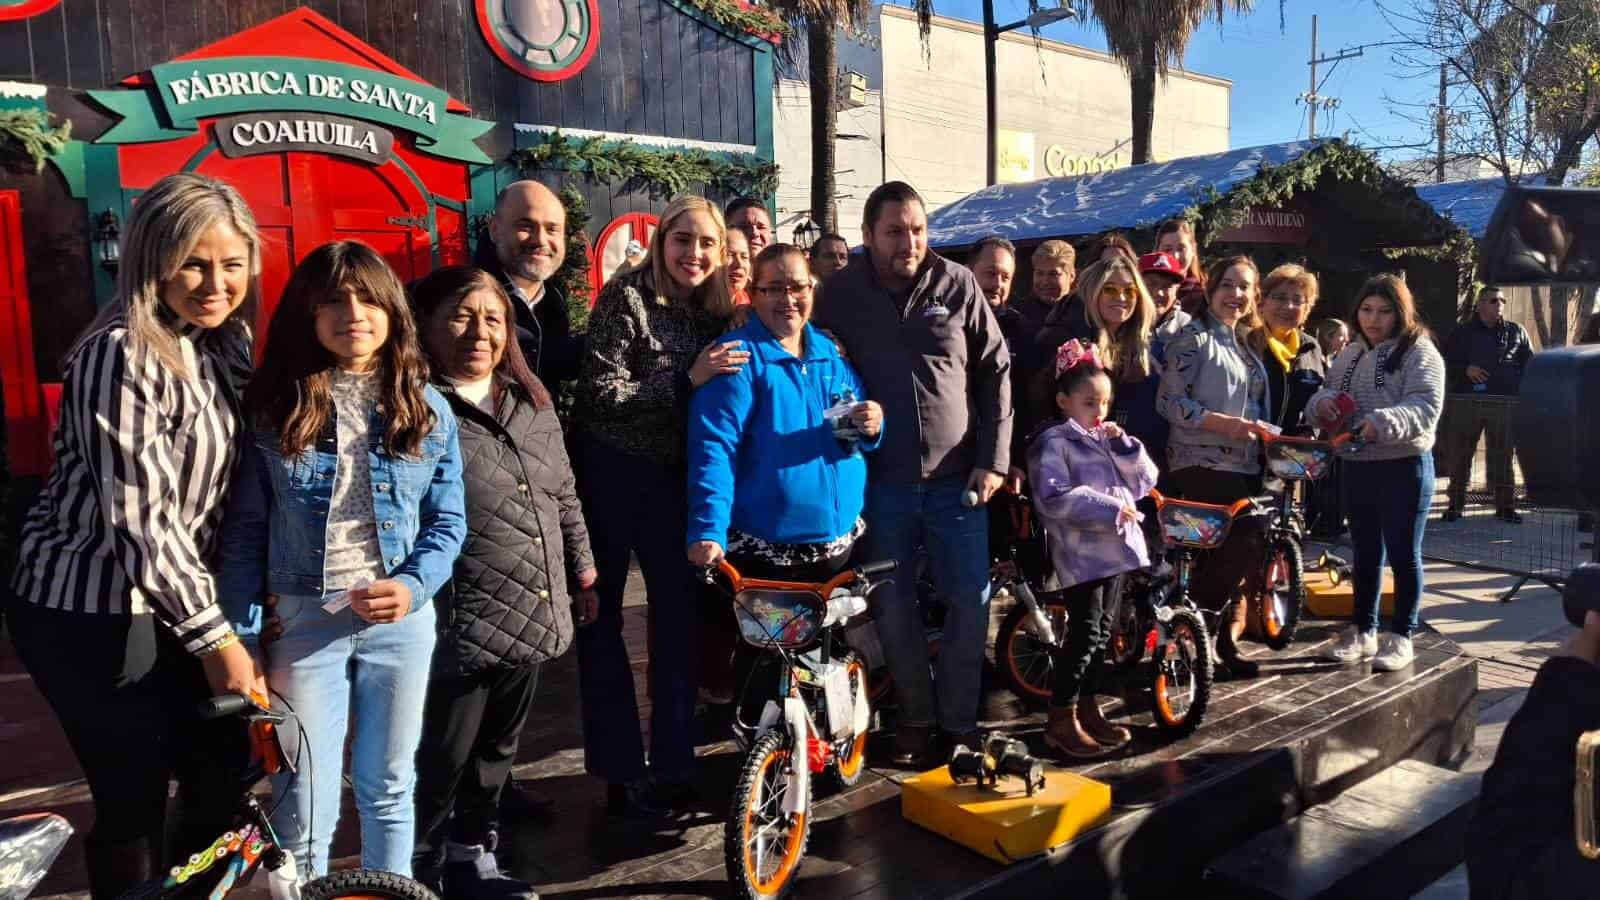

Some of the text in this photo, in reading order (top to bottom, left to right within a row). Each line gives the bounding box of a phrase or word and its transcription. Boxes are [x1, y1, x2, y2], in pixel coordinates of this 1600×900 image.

[169, 70, 437, 124] FÁBRICA DE SANTA
[231, 120, 379, 154] COAHUILA
